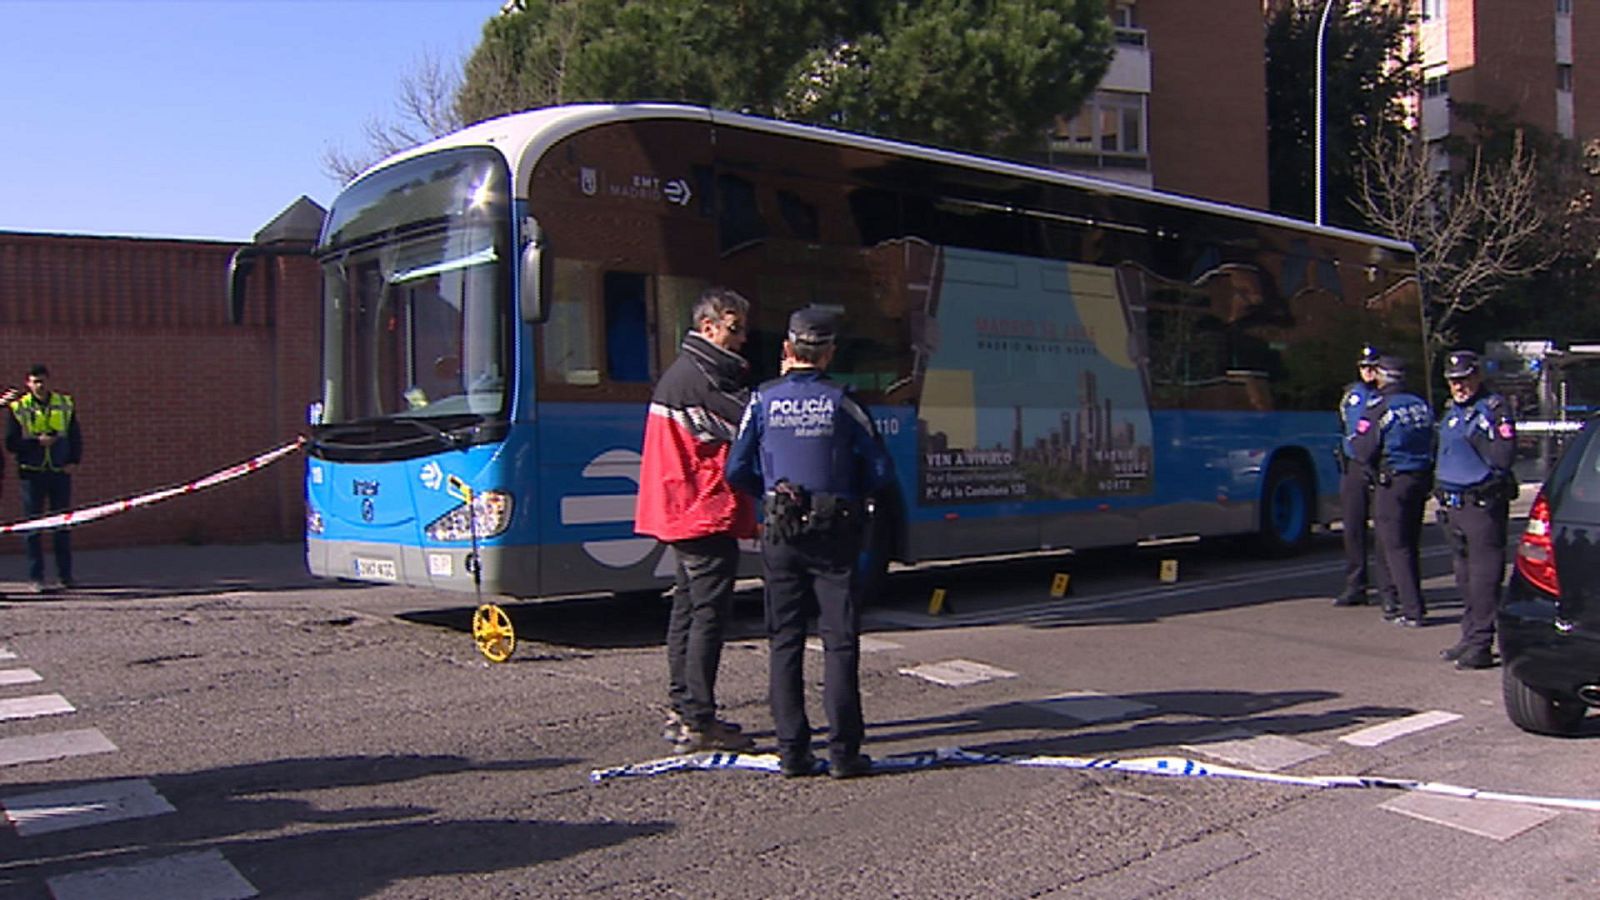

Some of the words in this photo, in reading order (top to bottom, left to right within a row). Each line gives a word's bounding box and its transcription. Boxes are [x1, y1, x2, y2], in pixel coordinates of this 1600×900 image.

[769, 394, 834, 415] POLICÍA
[768, 413, 834, 428] MUNICIPAL
[925, 453, 952, 467] VEN
[954, 453, 964, 466] A
